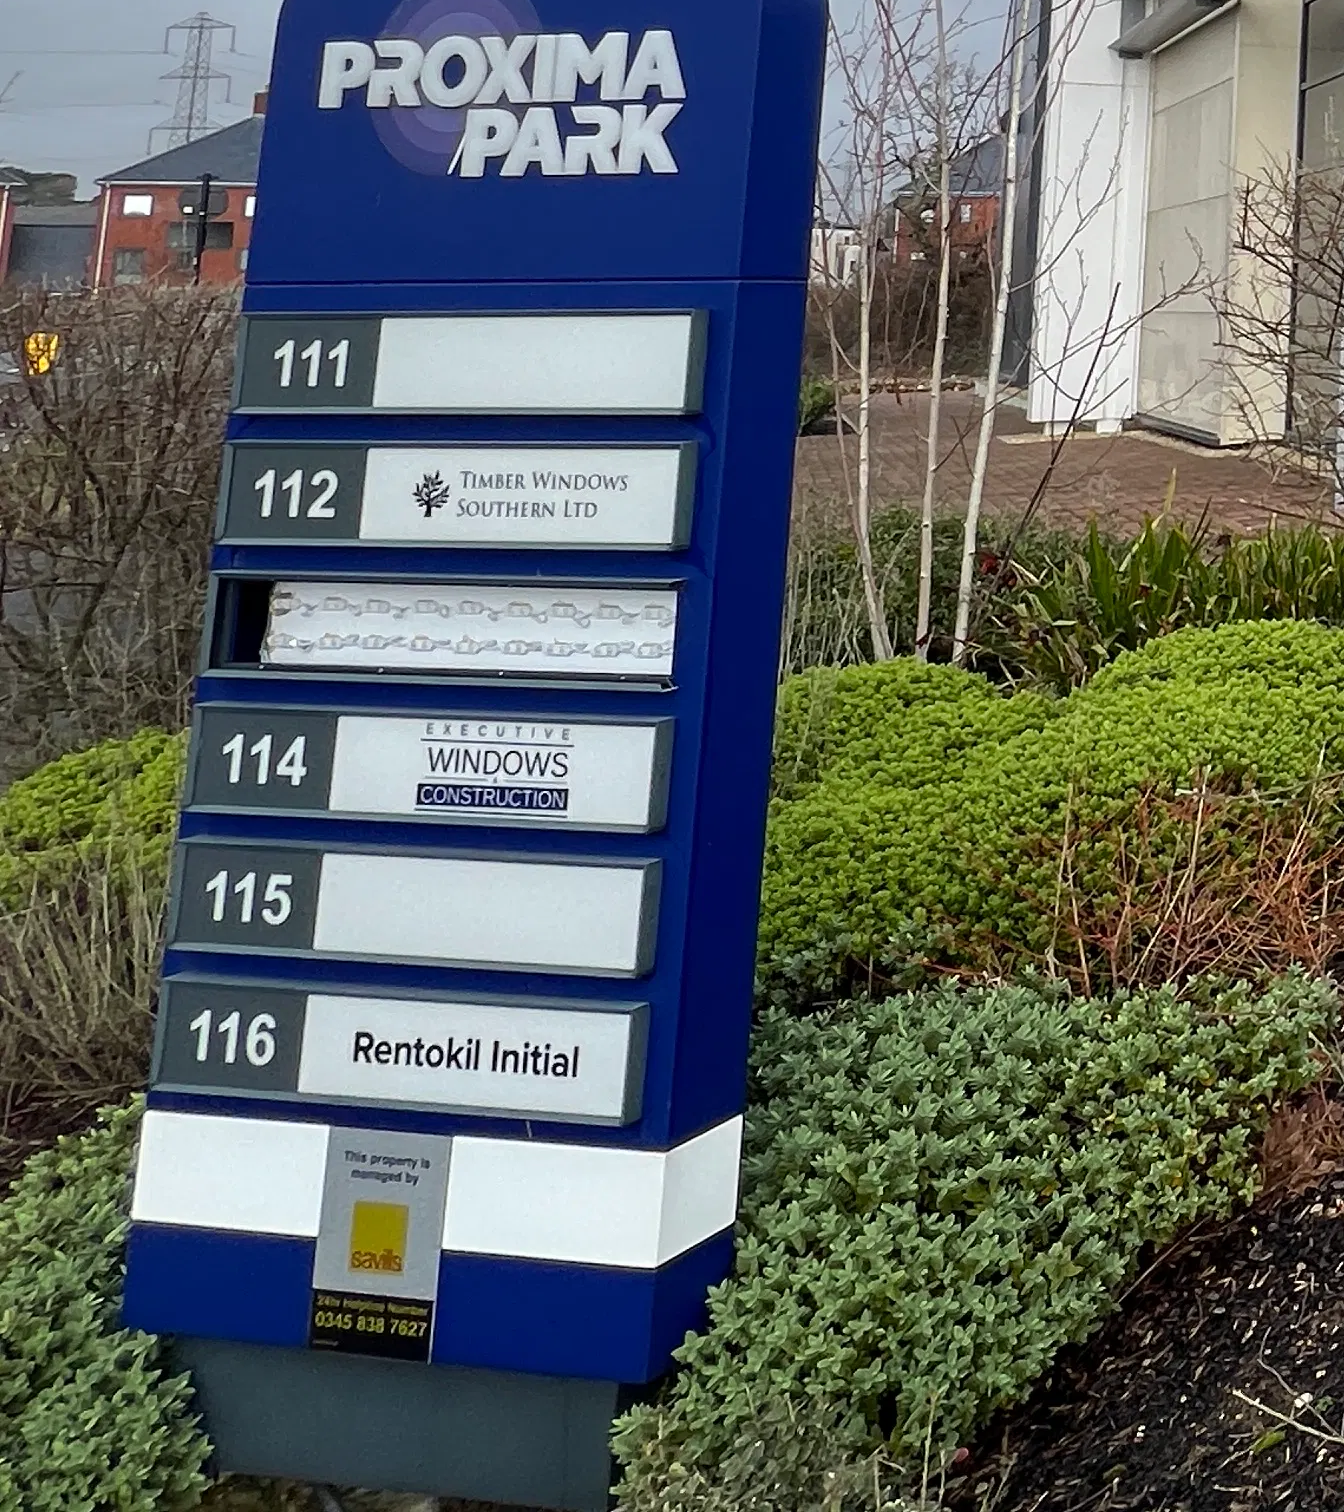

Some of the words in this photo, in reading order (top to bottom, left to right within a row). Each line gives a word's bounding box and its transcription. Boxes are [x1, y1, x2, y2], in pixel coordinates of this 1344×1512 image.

[318, 29, 687, 109] PROXIMA
[458, 103, 684, 178] PARK
[273, 339, 350, 387] 111
[254, 468, 339, 518] 112
[460, 470, 526, 489] TIMBER
[532, 471, 629, 491] WINDOWS
[456, 498, 556, 518] SOUTHERN
[426, 722, 571, 740] EXECUTIVE
[222, 733, 308, 786] 114
[428, 746, 568, 778] WINDOWS
[420, 786, 566, 808] CONSTRUCTION
[205, 870, 293, 926] 115
[189, 1009, 277, 1066] 116
[353, 1031, 481, 1071] Rentokil
[490, 1040, 580, 1078] Initial
[344, 1150, 367, 1163] This
[370, 1154, 417, 1169] property
[421, 1157, 430, 1169] is
[405, 1171, 419, 1186] by
[315, 1310, 353, 1330] 0345
[390, 1318, 428, 1337] 7627
